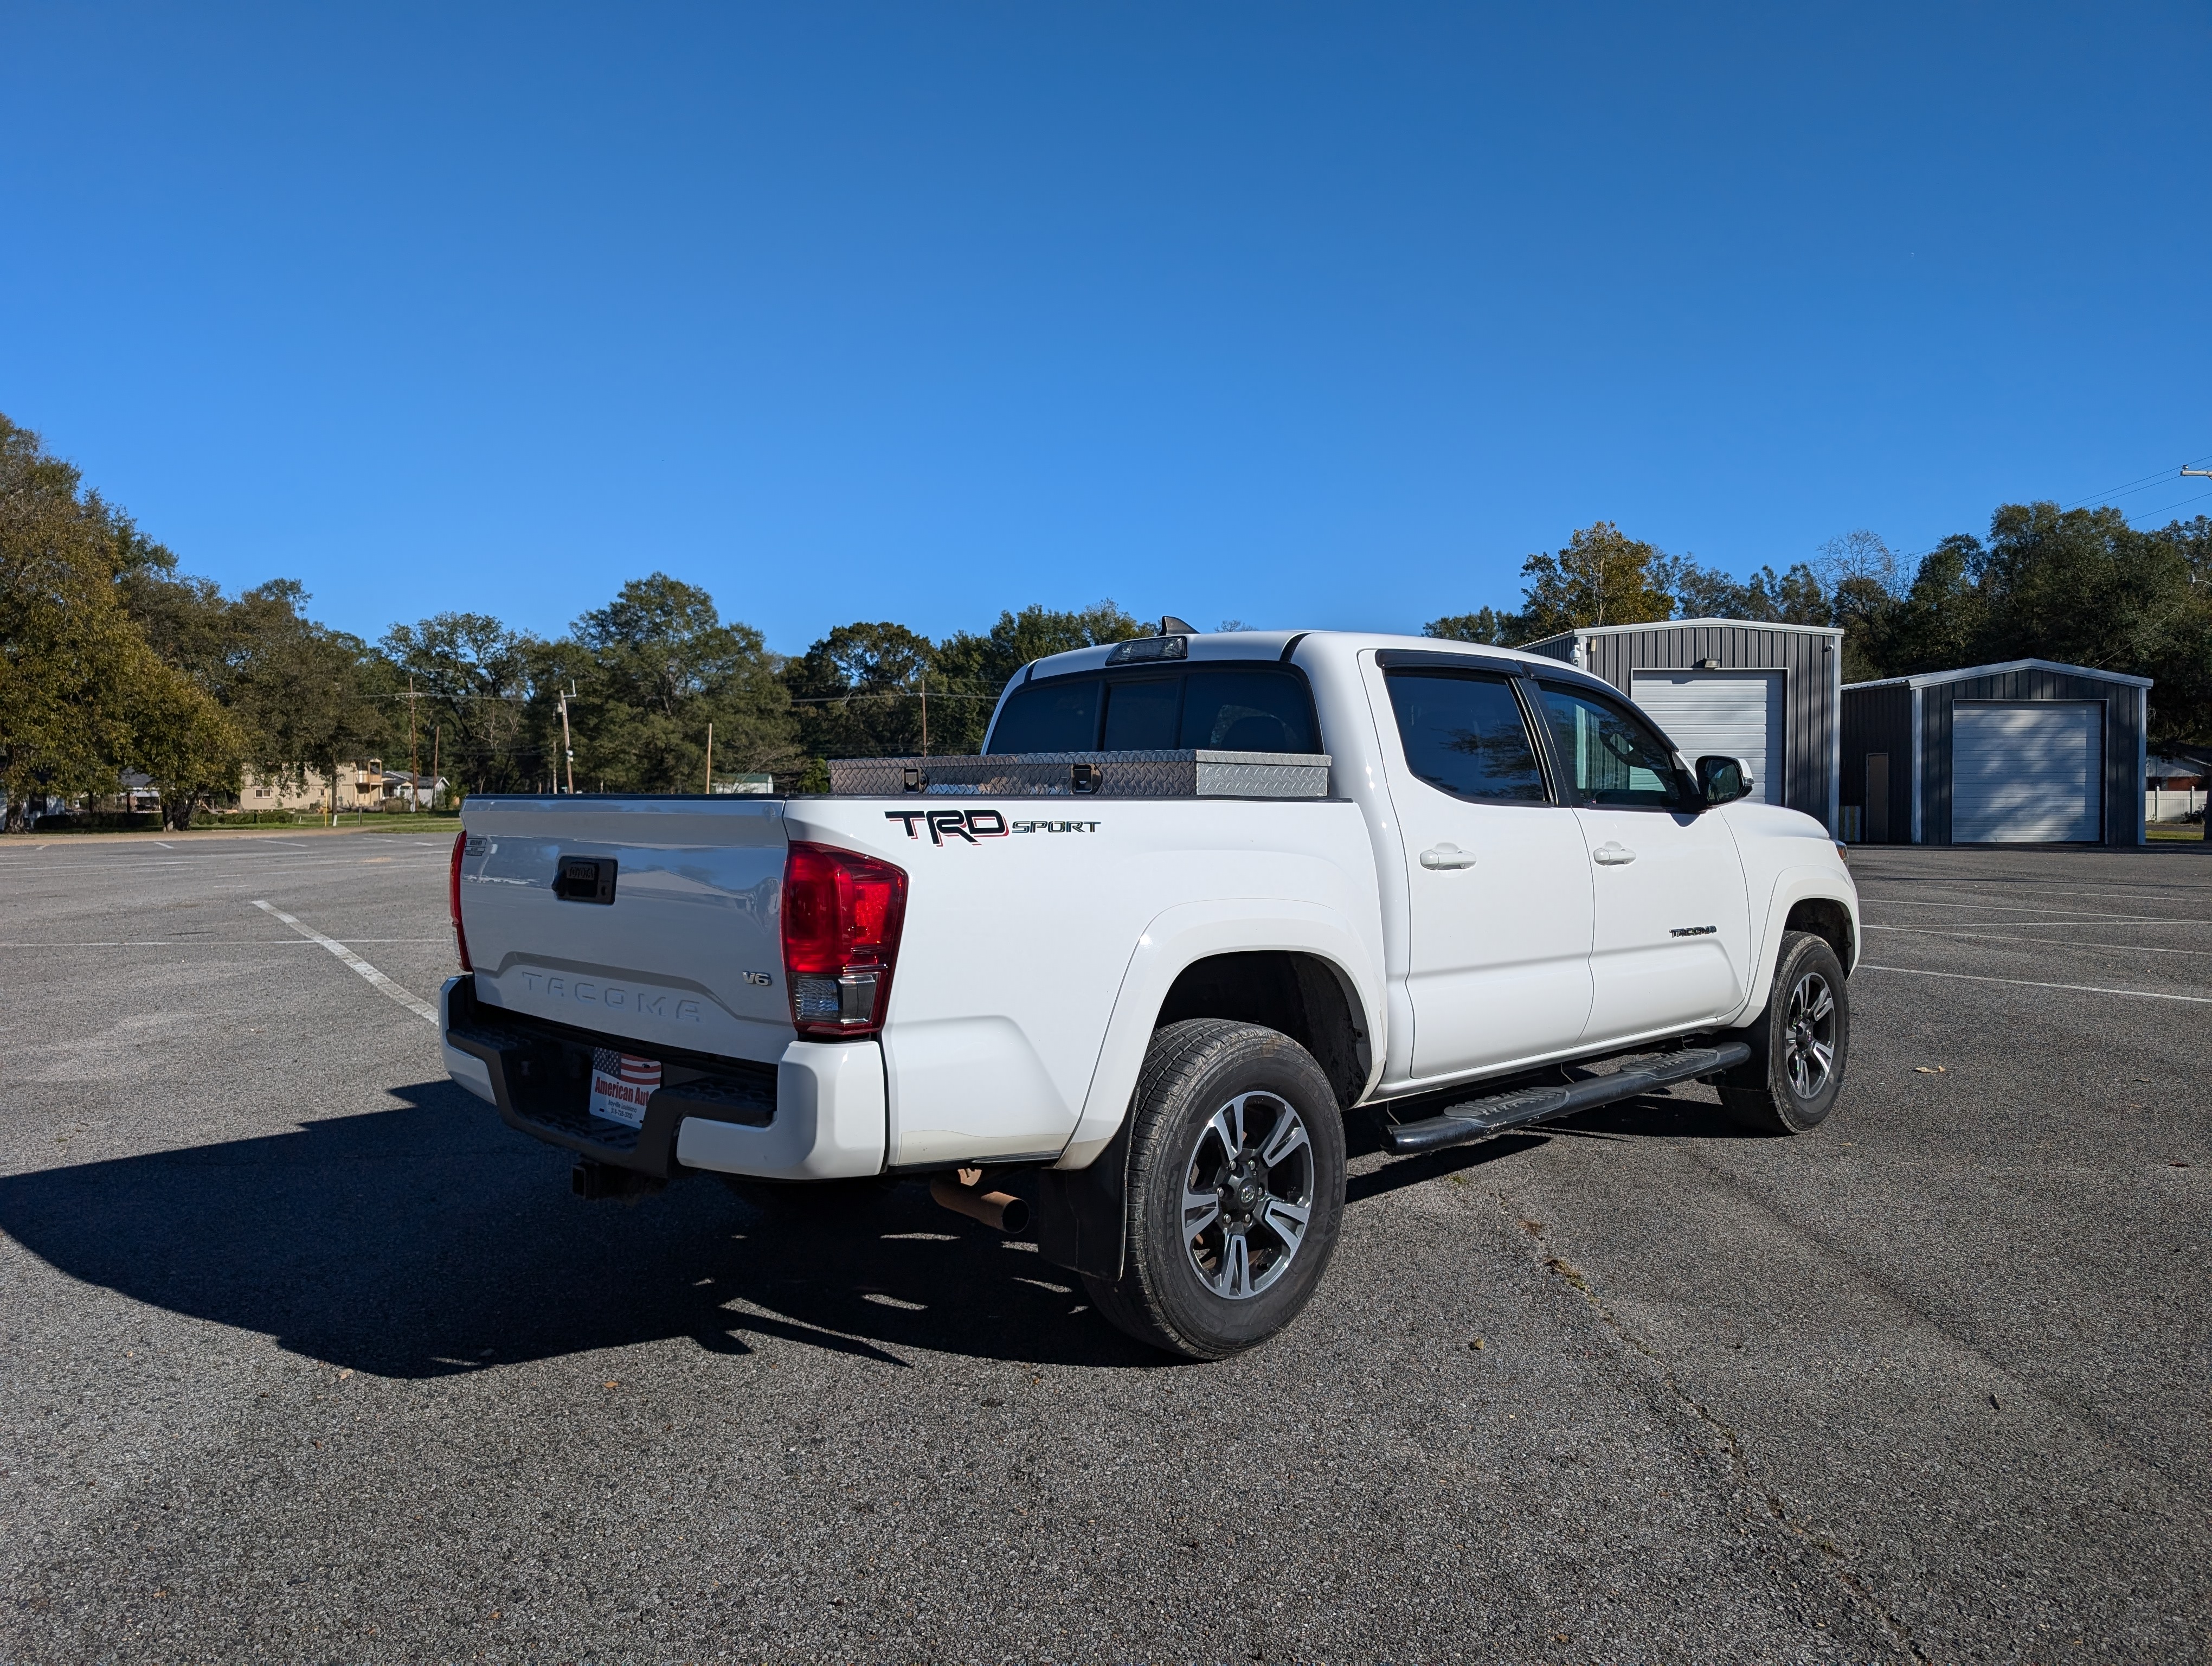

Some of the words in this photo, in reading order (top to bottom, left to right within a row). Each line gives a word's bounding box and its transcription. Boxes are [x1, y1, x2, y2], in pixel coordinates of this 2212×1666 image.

[884, 810, 1009, 847] TRD
[1012, 821, 1101, 834] SPORT
[567, 866, 594, 879] TOYOTA
[1669, 925, 1717, 938] TACOMA
[742, 970, 772, 986] V6
[522, 971, 705, 1023] TACOMA
[595, 1077, 634, 1103] American
[634, 1087, 651, 1107] Aut
